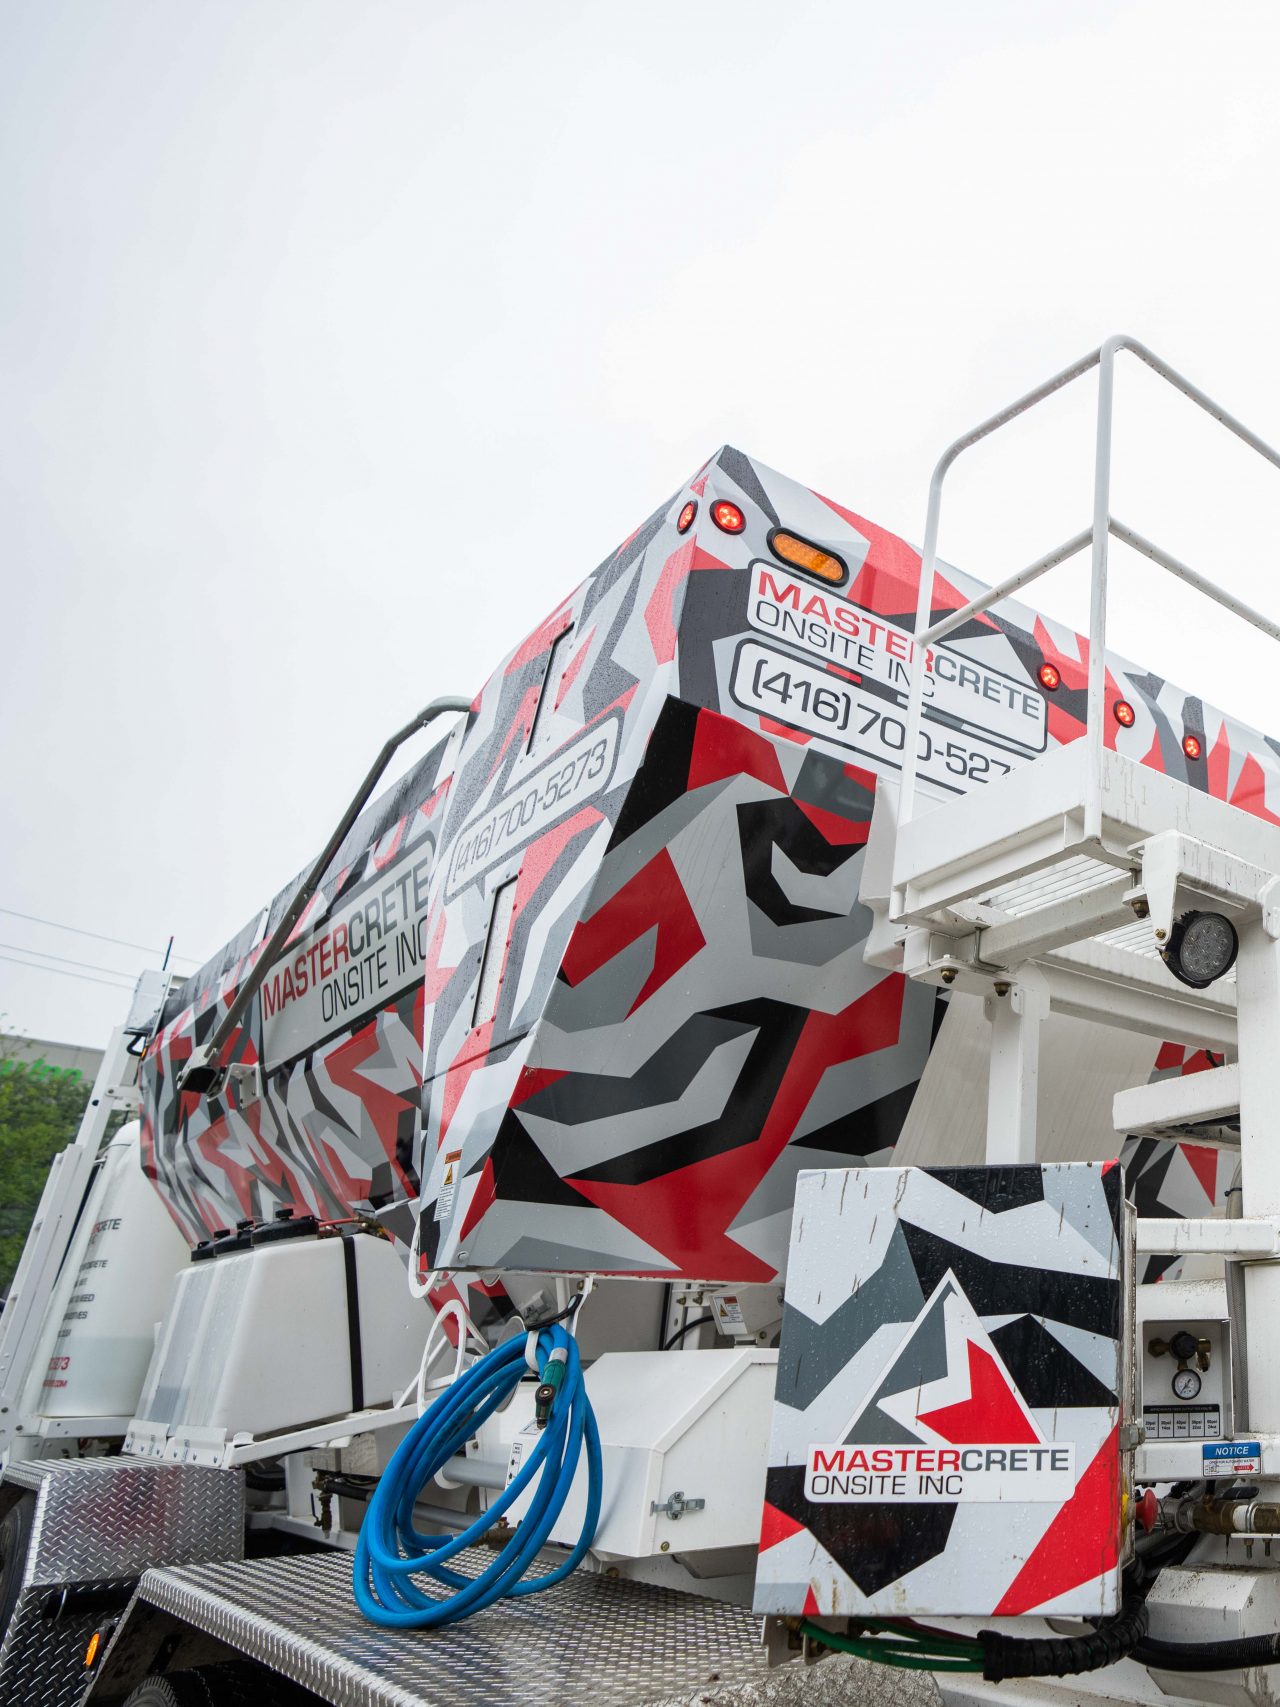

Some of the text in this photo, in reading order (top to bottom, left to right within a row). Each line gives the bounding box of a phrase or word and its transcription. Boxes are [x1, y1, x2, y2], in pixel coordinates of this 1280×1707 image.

[755, 600, 875, 671] ONSITE
[263, 856, 429, 1021] MASTERCRETE
[321, 914, 428, 1023] ONSITE INC
[812, 1449, 1070, 1472] MASTERCRETE
[1215, 1446, 1250, 1456] NOTICE
[811, 1475, 964, 1495] ONSITE INC
